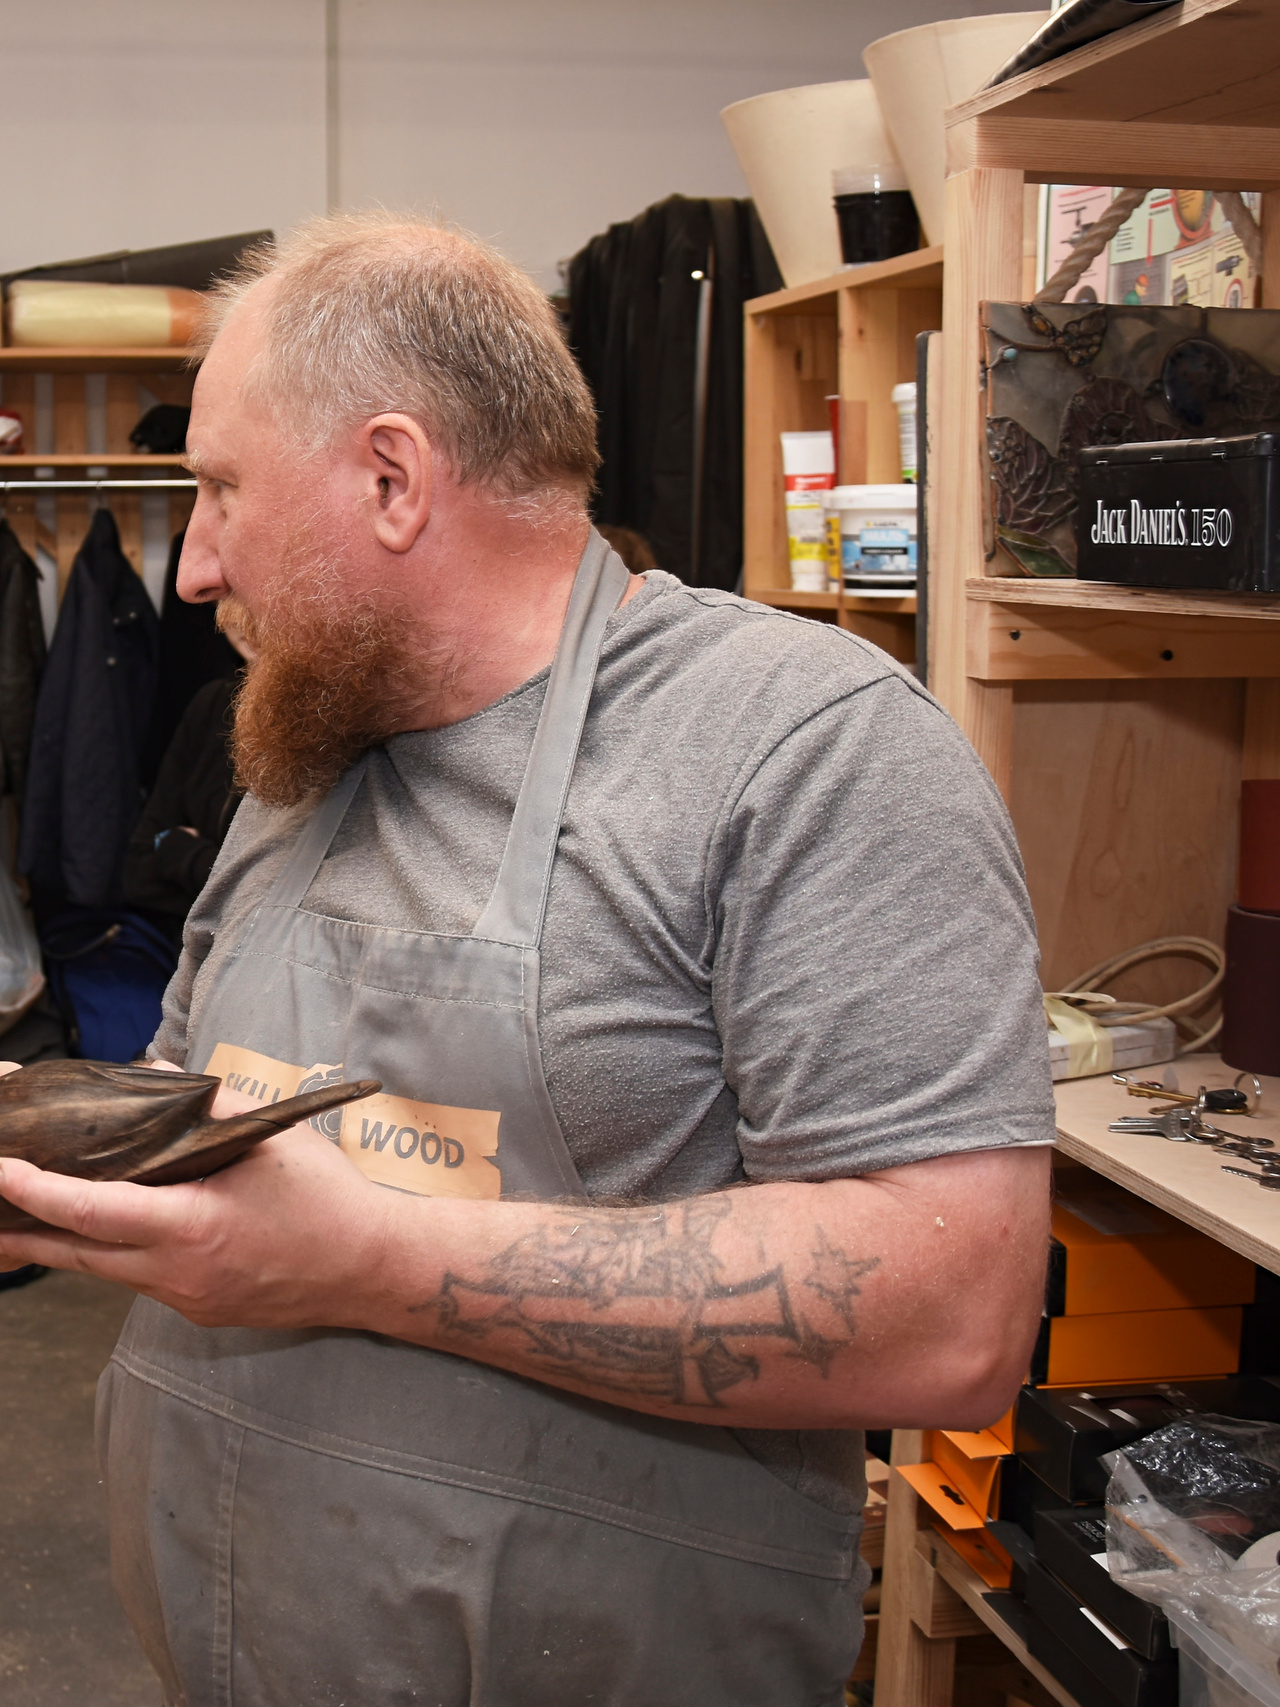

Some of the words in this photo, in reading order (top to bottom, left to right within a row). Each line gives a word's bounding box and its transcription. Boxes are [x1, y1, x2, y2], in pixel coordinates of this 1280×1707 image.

[1090, 499, 1128, 545] JACK
[1190, 508, 1233, 548] 150
[360, 1117, 465, 1168] WOOD
